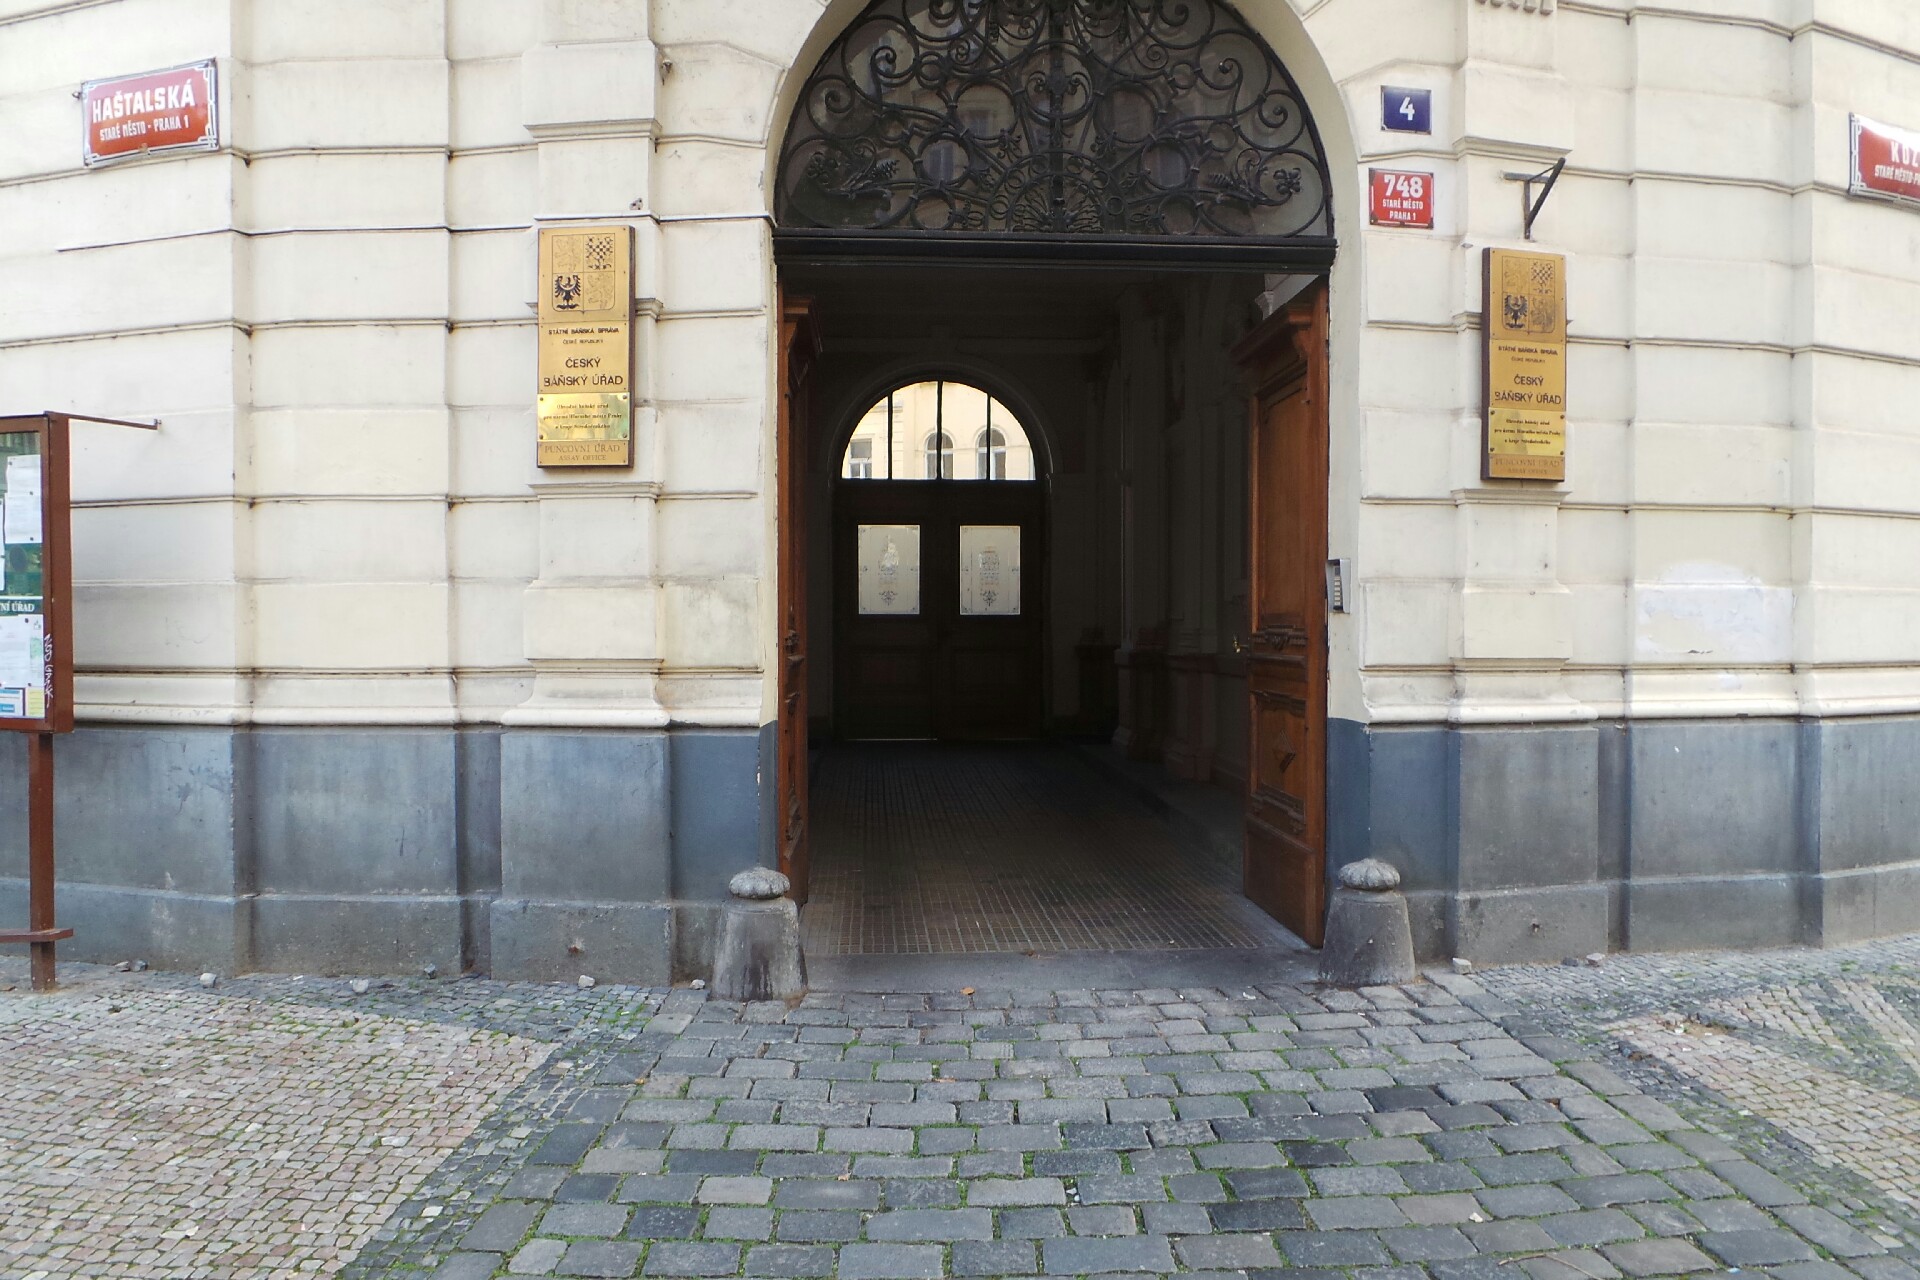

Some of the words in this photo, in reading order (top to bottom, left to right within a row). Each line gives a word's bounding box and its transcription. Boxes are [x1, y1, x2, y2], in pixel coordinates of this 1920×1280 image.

[92, 79, 196, 123] HAŠTALSKÁ
[1399, 96, 1415, 121] 4
[99, 123, 121, 142] STARÉ
[122, 119, 146, 138] MĚSTO
[153, 117, 181, 132] PRAHA
[184, 115, 189, 128] 1
[1384, 174, 1423, 198] 748
[1382, 197, 1401, 208] STARÉ
[1402, 199, 1424, 210] MĚSTO
[1389, 210, 1411, 220] PRAHA
[1412, 212, 1416, 220] 1
[565, 356, 601, 368] ČESKÝ
[544, 374, 588, 386] BÁŇSKÝ
[592, 373, 624, 386] ÚŘAD
[1514, 374, 1544, 386] ČESKÝ
[1495, 390, 1534, 402] BÁŇSKÝ
[1536, 392, 1562, 404] ÚŘAD
[544, 444, 590, 454] PUNCOVNÍ
[11, 600, 35, 612] ÚŘAD
